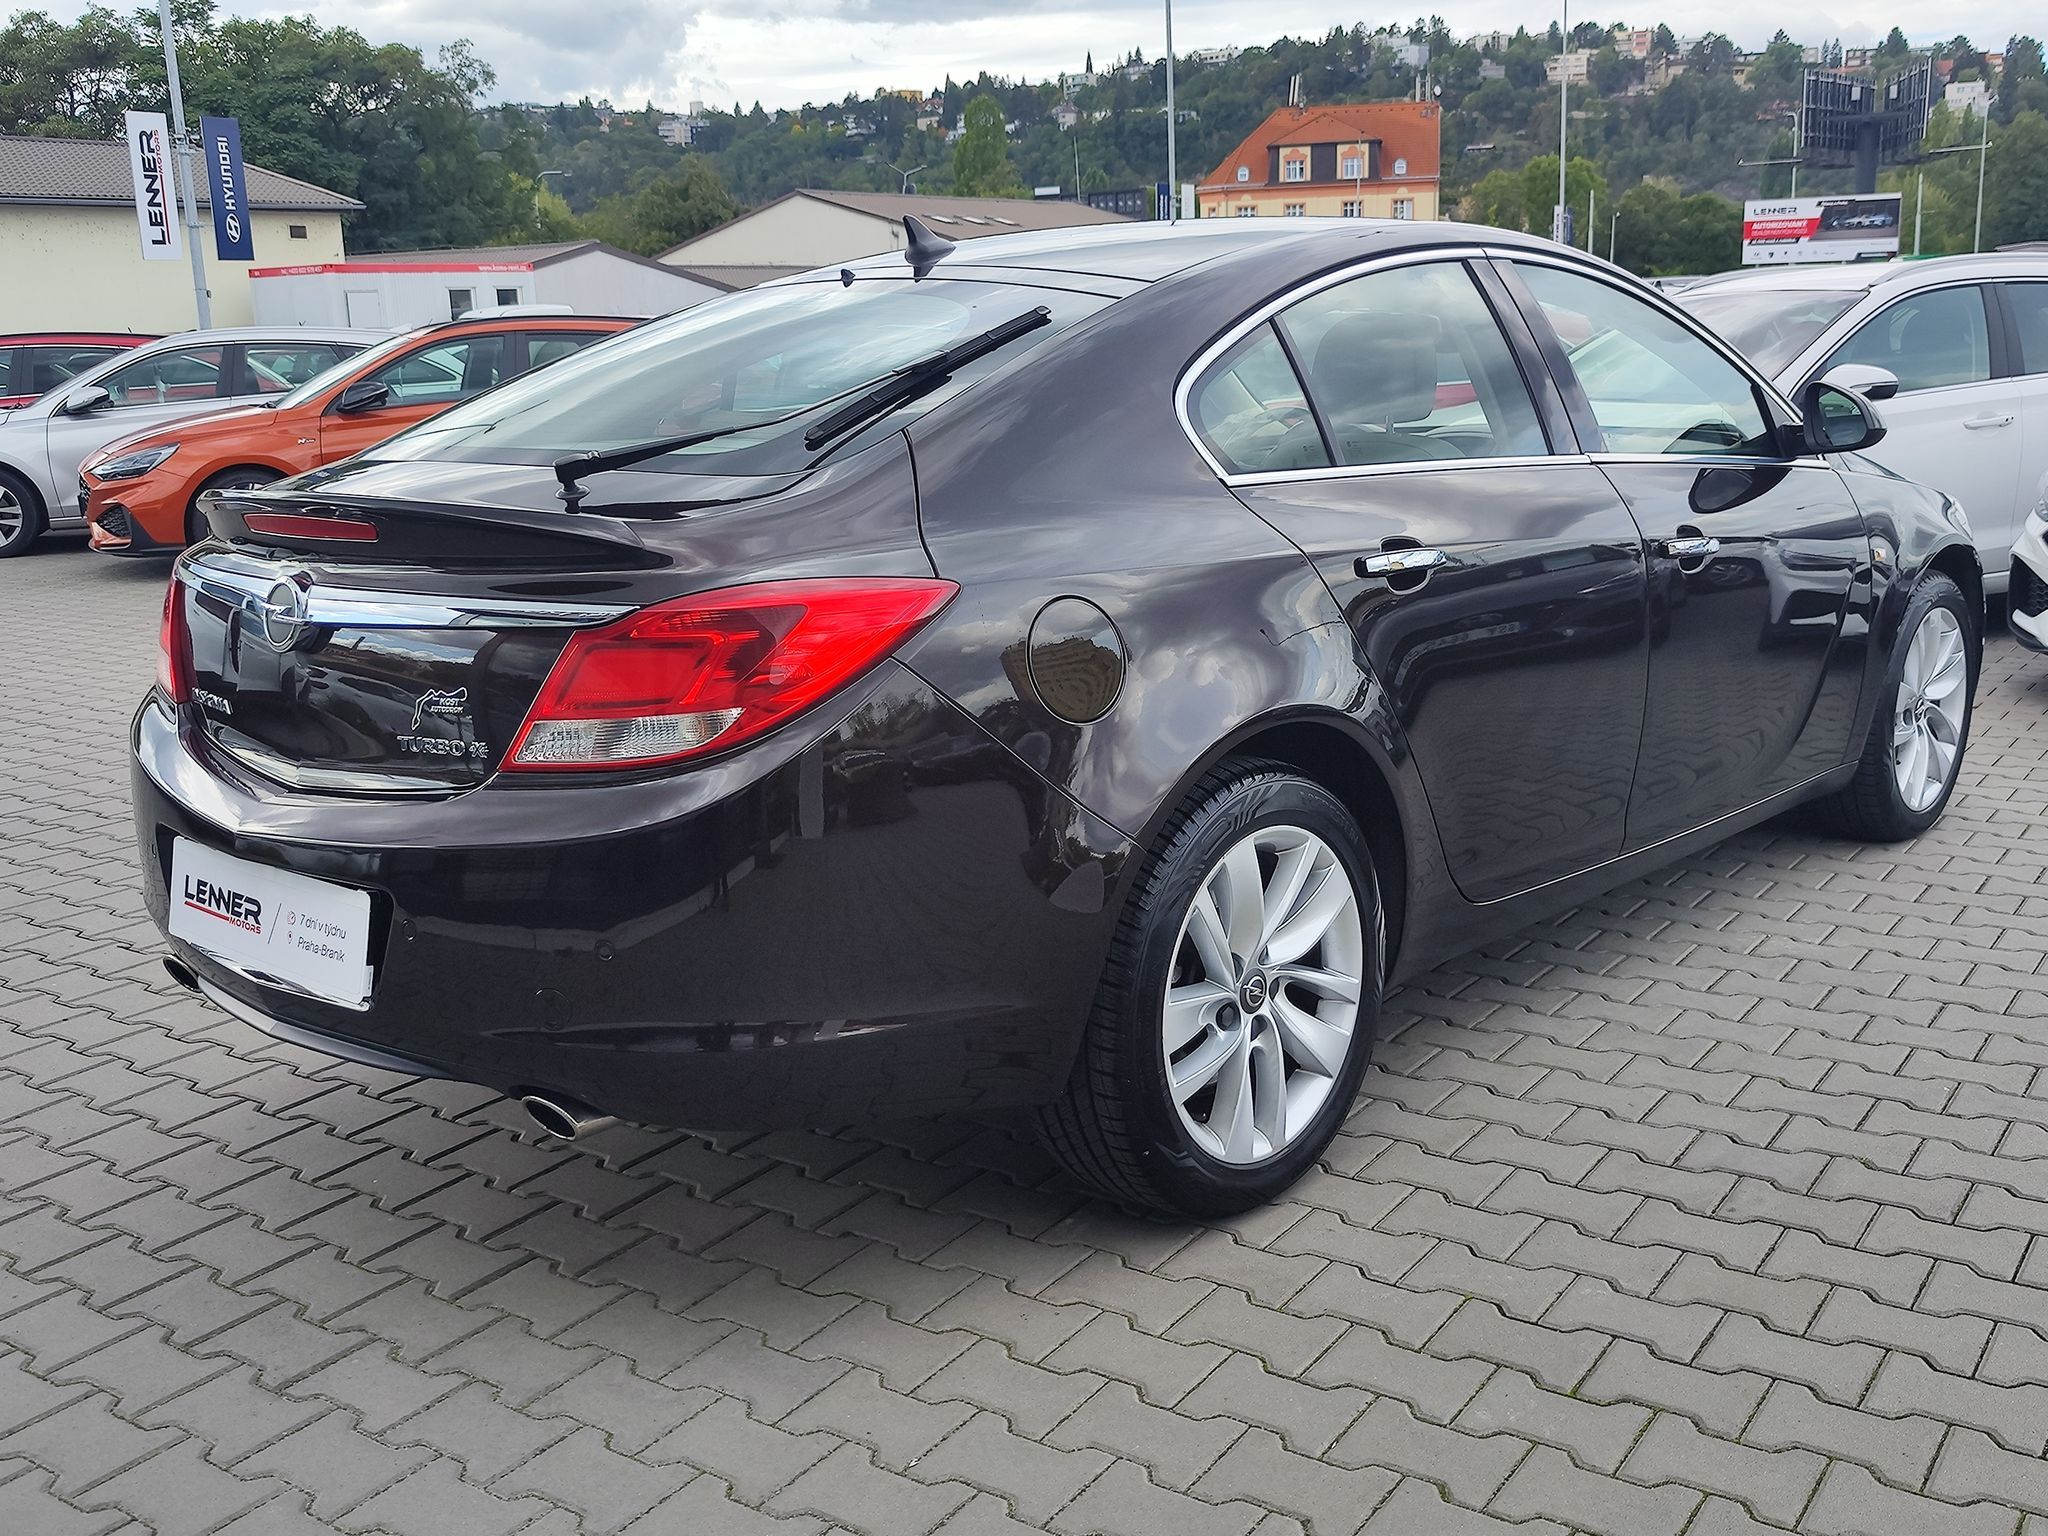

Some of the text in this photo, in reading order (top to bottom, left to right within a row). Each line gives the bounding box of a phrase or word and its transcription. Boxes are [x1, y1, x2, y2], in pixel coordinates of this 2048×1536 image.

[153, 129, 164, 175] MOTORS
[139, 130, 167, 245] LENNER
[216, 136, 236, 211] HYUNDAI
[1753, 207, 1797, 216] LENNER
[397, 735, 466, 756] TURBO
[184, 874, 263, 926] LENNER
[228, 916, 262, 935] MOTORS
[300, 913, 306, 926] 7
[305, 917, 319, 930] dní
[324, 923, 347, 939] týdnu
